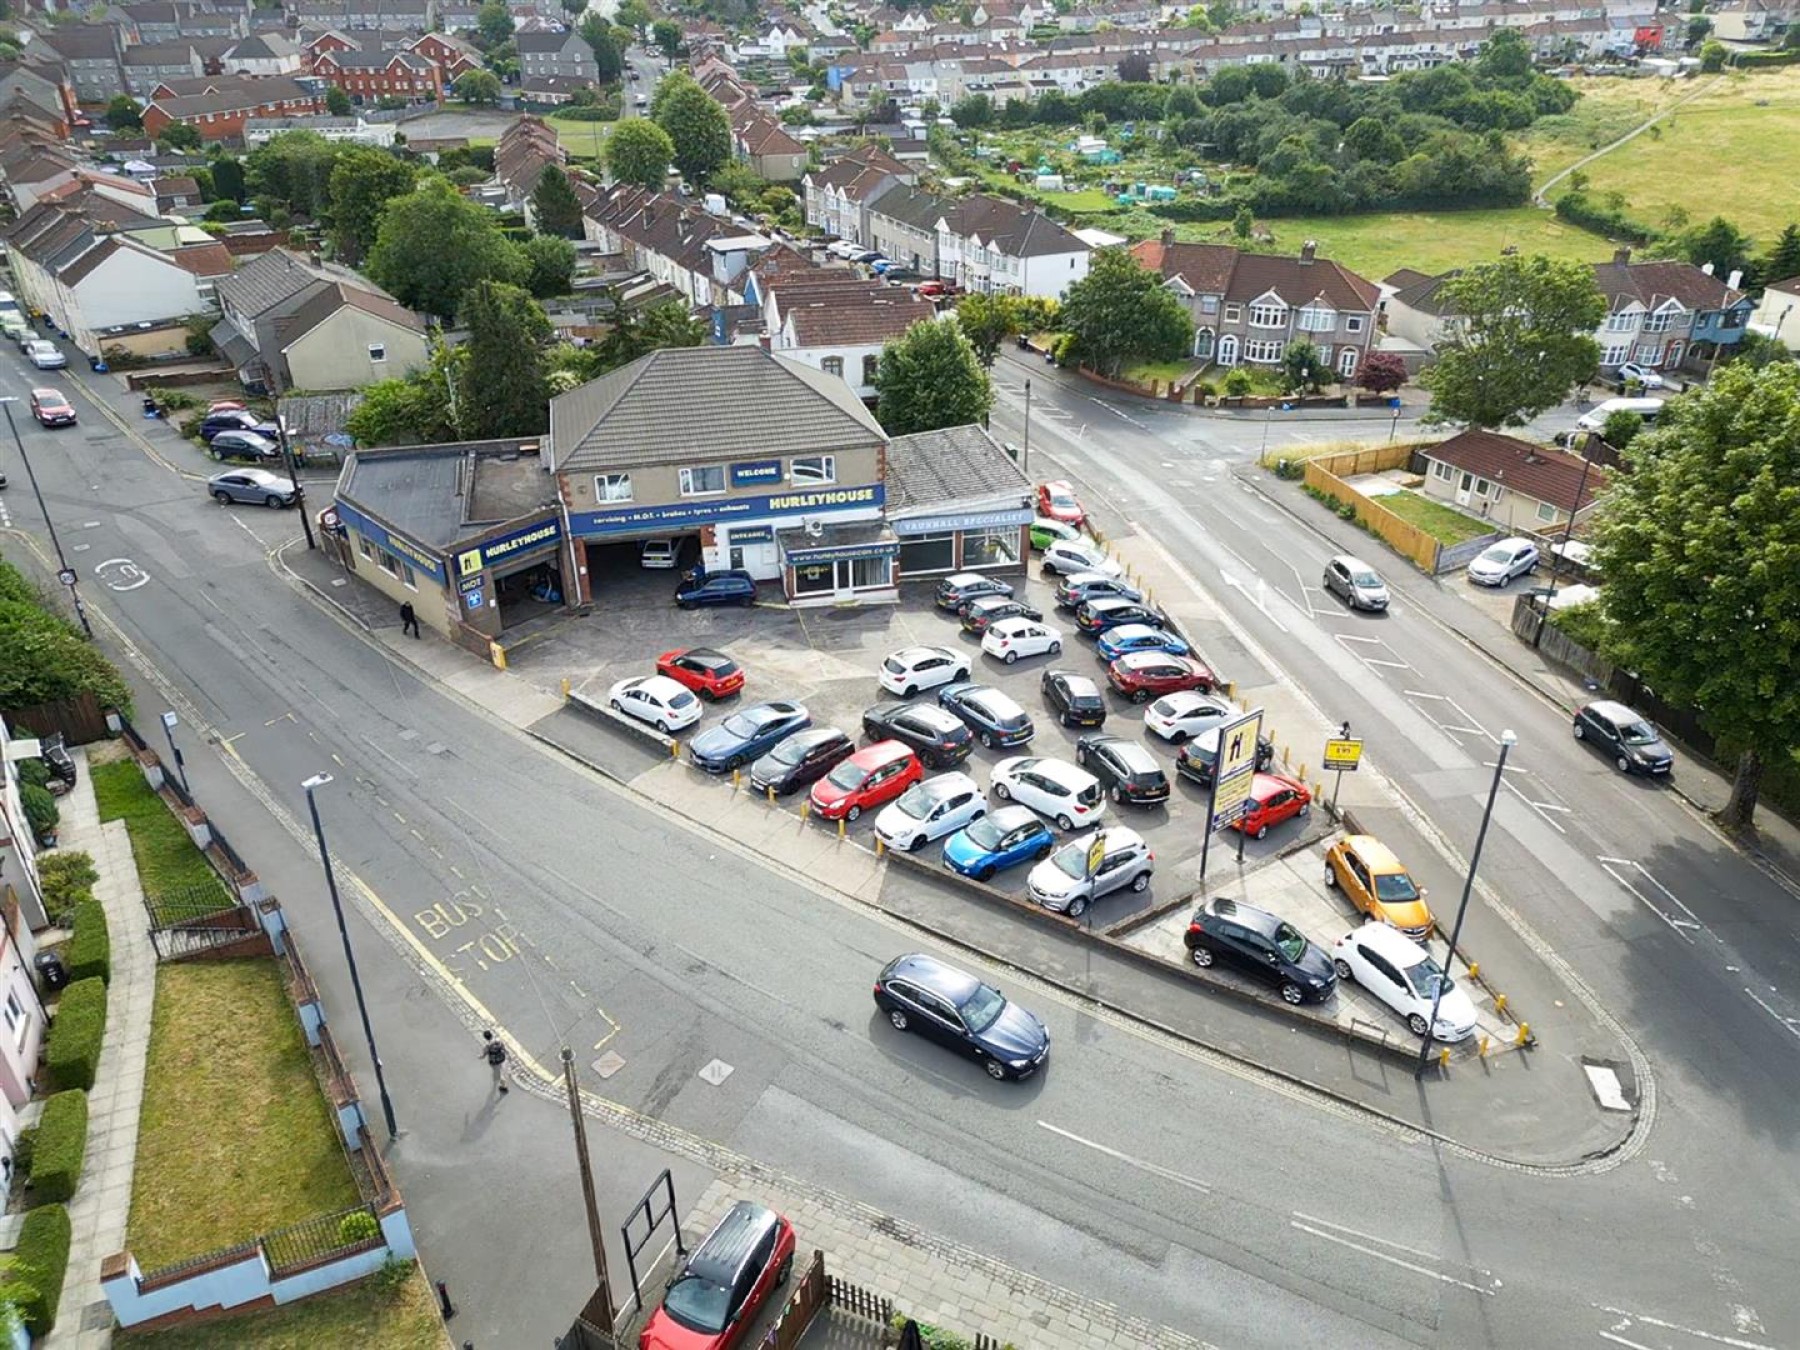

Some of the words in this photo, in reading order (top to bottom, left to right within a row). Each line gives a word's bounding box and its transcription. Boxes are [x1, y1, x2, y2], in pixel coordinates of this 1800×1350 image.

[737, 467, 776, 477] WELCOME
[769, 489, 874, 510] HURLEYHOUSE
[904, 519, 957, 531] VAUXHALL
[964, 513, 1022, 525] SPECIALIST
[486, 525, 556, 558] HURLEYHOUSE
[462, 578, 481, 592] MOT
[414, 891, 483, 939] BUS
